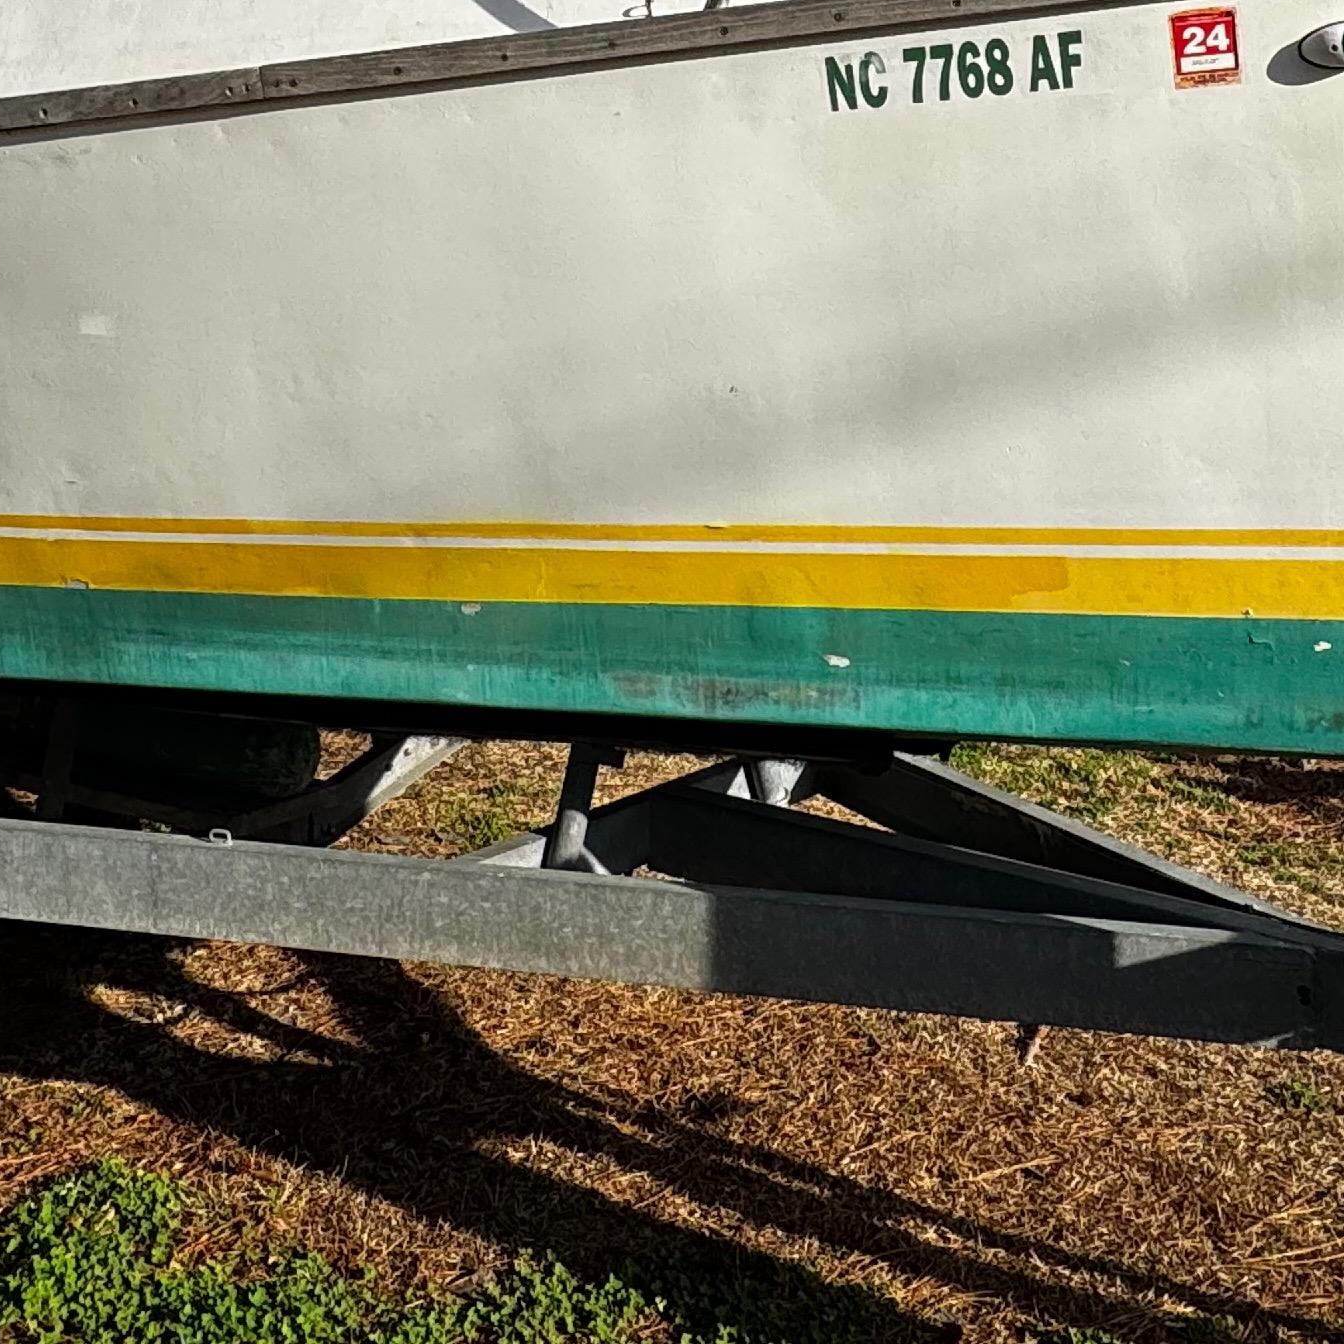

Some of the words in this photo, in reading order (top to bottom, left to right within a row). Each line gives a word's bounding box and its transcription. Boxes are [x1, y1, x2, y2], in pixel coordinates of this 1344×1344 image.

[1182, 23, 1230, 54] 24
[825, 51, 888, 111] NC
[903, 38, 1013, 103] 7768
[1029, 30, 1082, 92] AF
